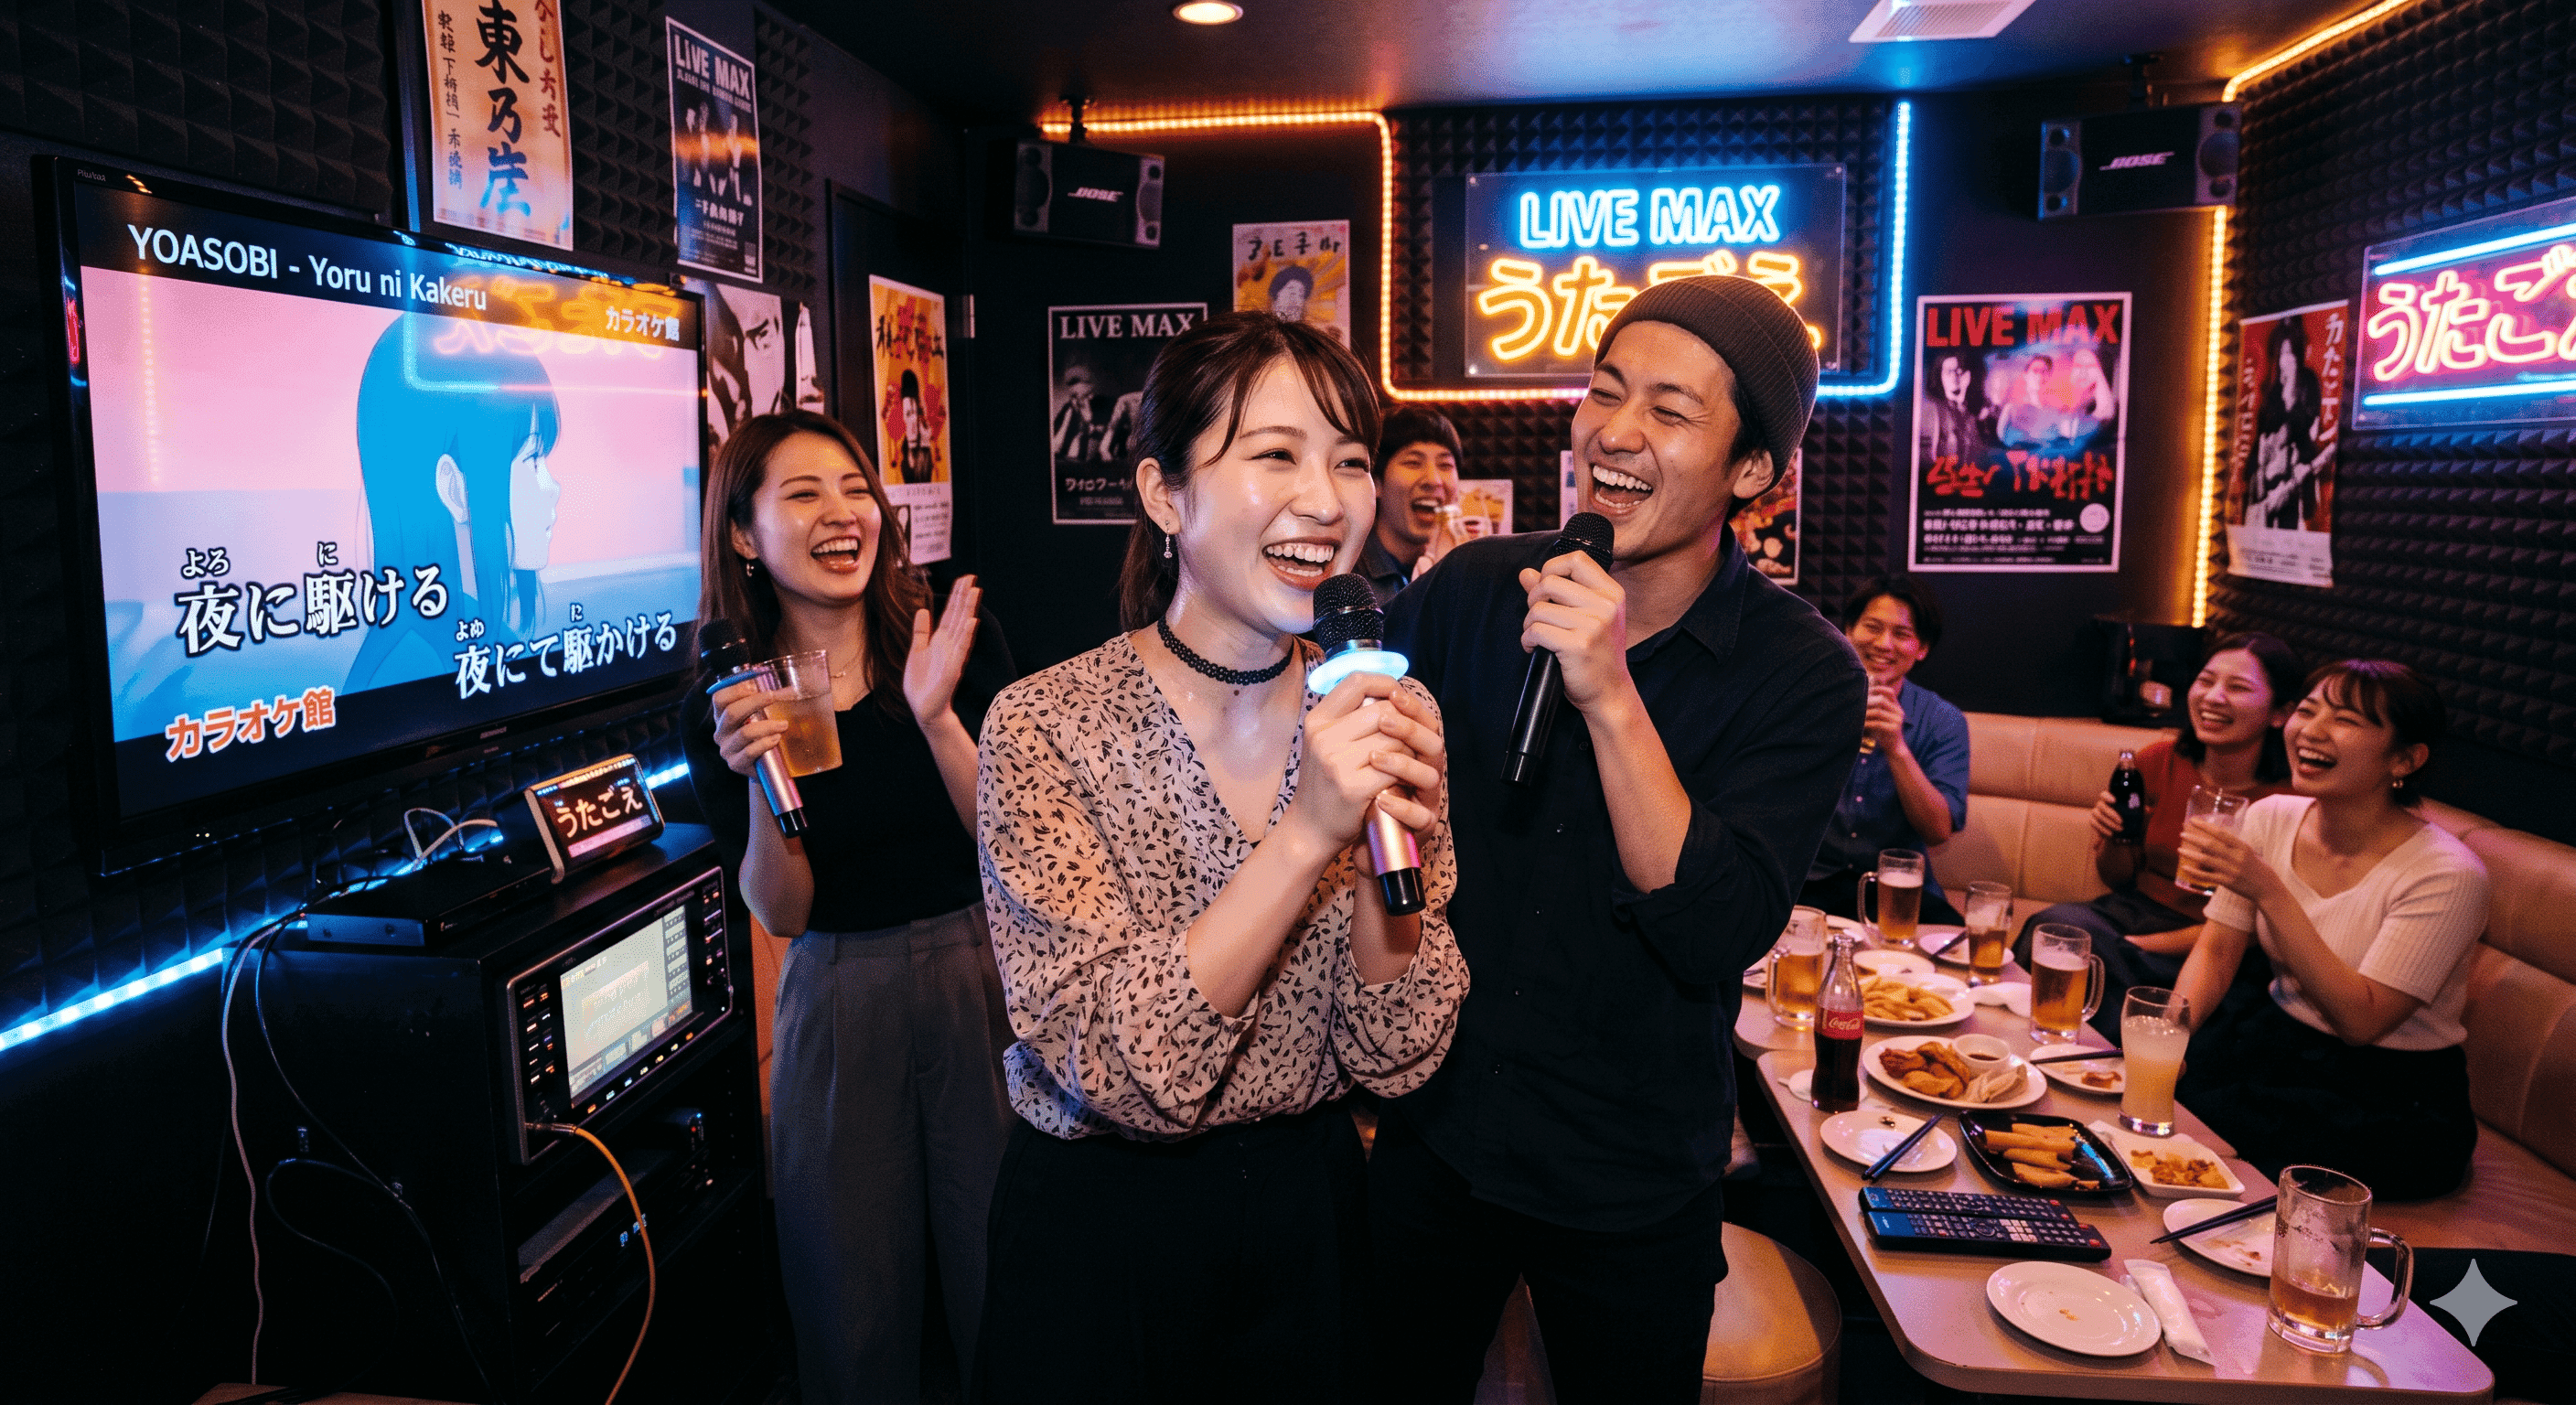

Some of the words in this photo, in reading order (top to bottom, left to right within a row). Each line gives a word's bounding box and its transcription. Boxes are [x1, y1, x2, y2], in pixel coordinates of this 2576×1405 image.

[674, 34, 710, 80] LIVE
[714, 55, 751, 101] MAX
[1519, 188, 1640, 250] LIVE
[1649, 185, 1781, 245] MAX
[127, 224, 278, 280] YOASOBI
[308, 254, 371, 296] Yoru
[380, 269, 402, 299] ni
[409, 271, 488, 312] Kakeru
[1059, 315, 1123, 340] LIVE
[1131, 313, 1197, 339] MAX
[1927, 306, 2014, 348] LIVE
[2026, 304, 2120, 346] MAX
[182, 548, 231, 577] よろ
[317, 541, 338, 566] に
[177, 564, 449, 656] 夜に駆ける
[570, 603, 584, 621] に
[454, 611, 677, 700] 夜にて駆かける
[165, 685, 337, 763] カラオケ館
[556, 785, 643, 838] うたごえ
